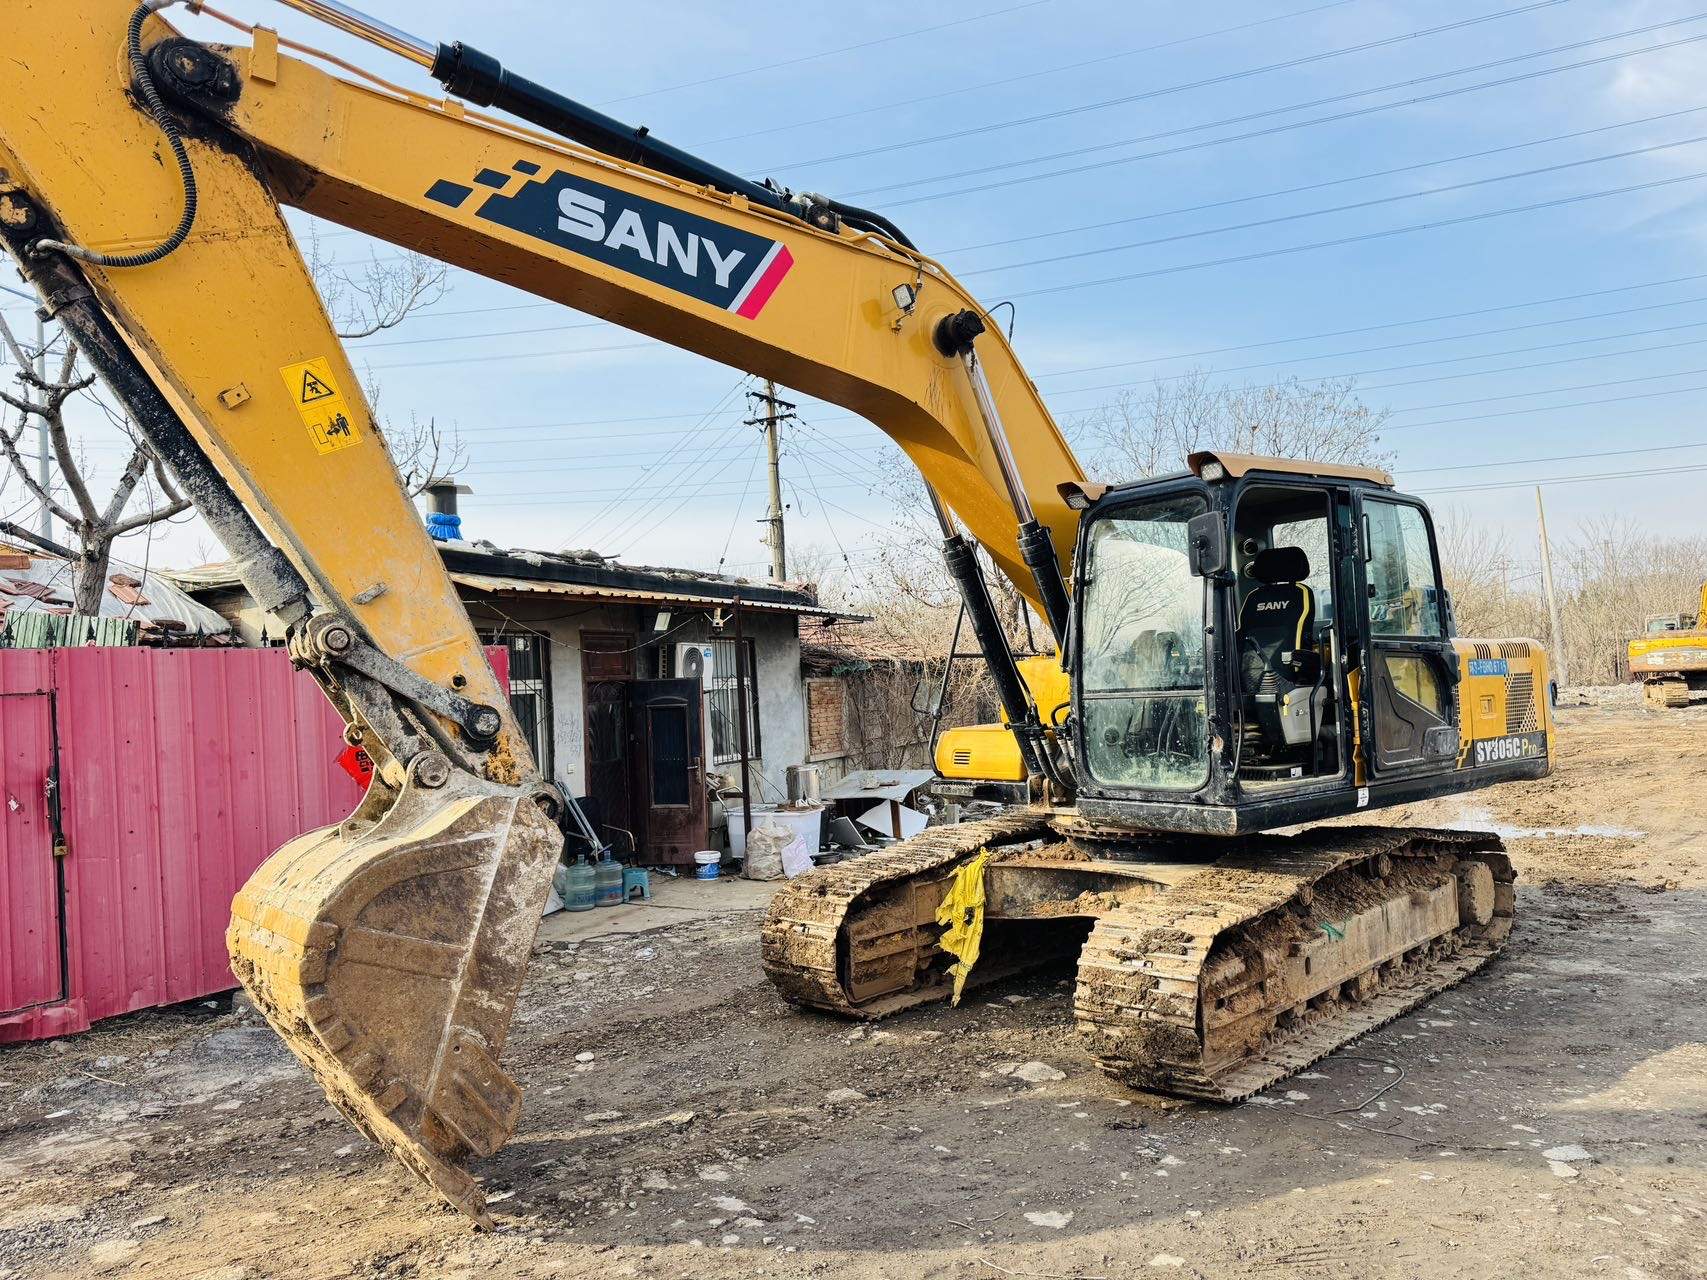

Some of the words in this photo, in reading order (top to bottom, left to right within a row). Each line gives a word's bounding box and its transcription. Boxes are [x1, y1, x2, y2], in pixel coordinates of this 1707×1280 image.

[557, 187, 746, 288] SANY
[1256, 600, 1290, 611] SANY
[1476, 737, 1520, 762] SY305C
[1521, 738, 1537, 756] Pro
